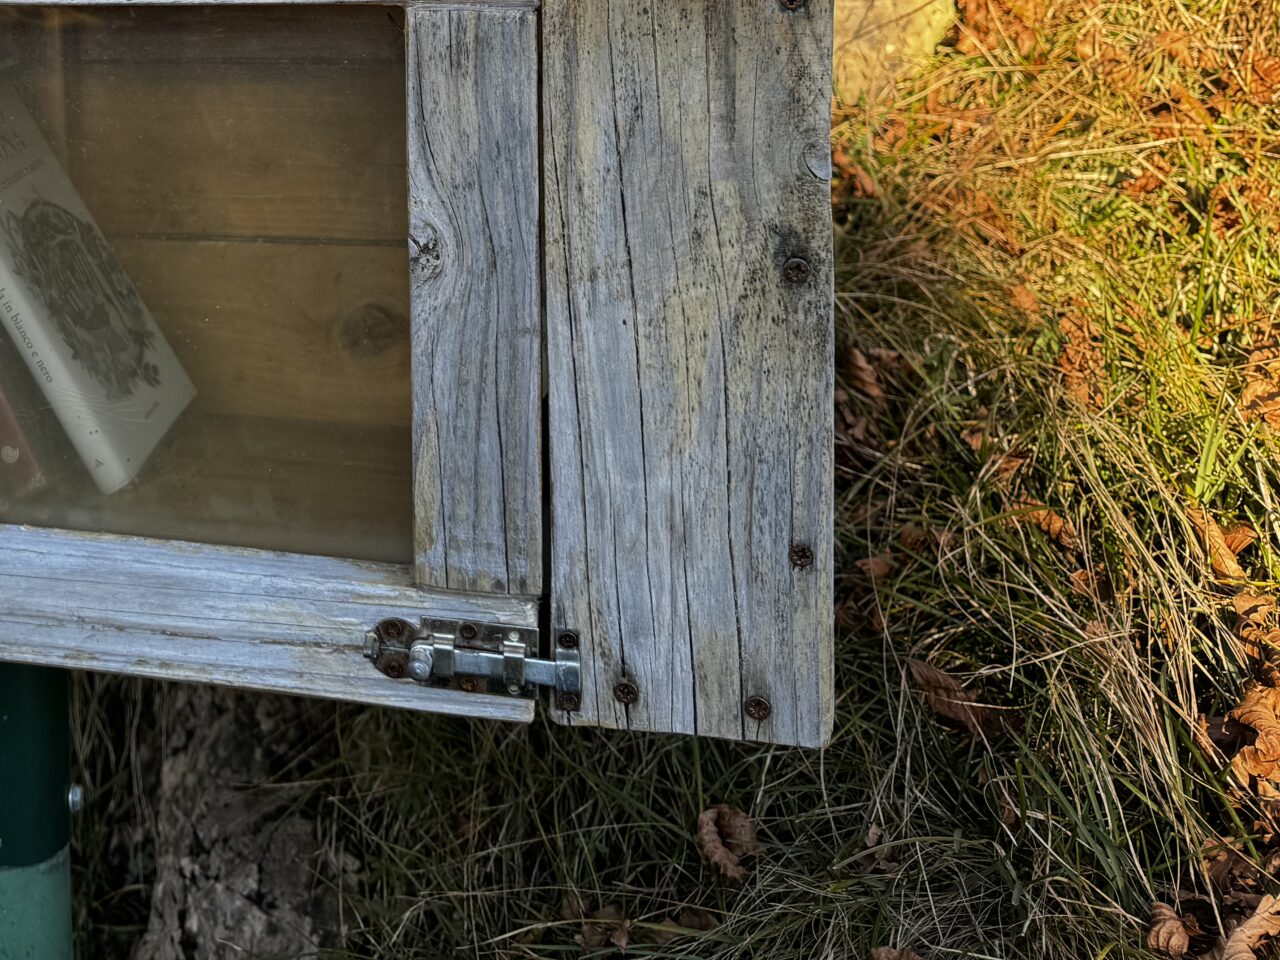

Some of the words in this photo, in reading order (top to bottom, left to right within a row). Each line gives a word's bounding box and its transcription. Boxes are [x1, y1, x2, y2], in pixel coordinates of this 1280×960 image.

[1, 299, 14, 313] in
[10, 311, 33, 349] bianco
[36, 358, 54, 384] nero
